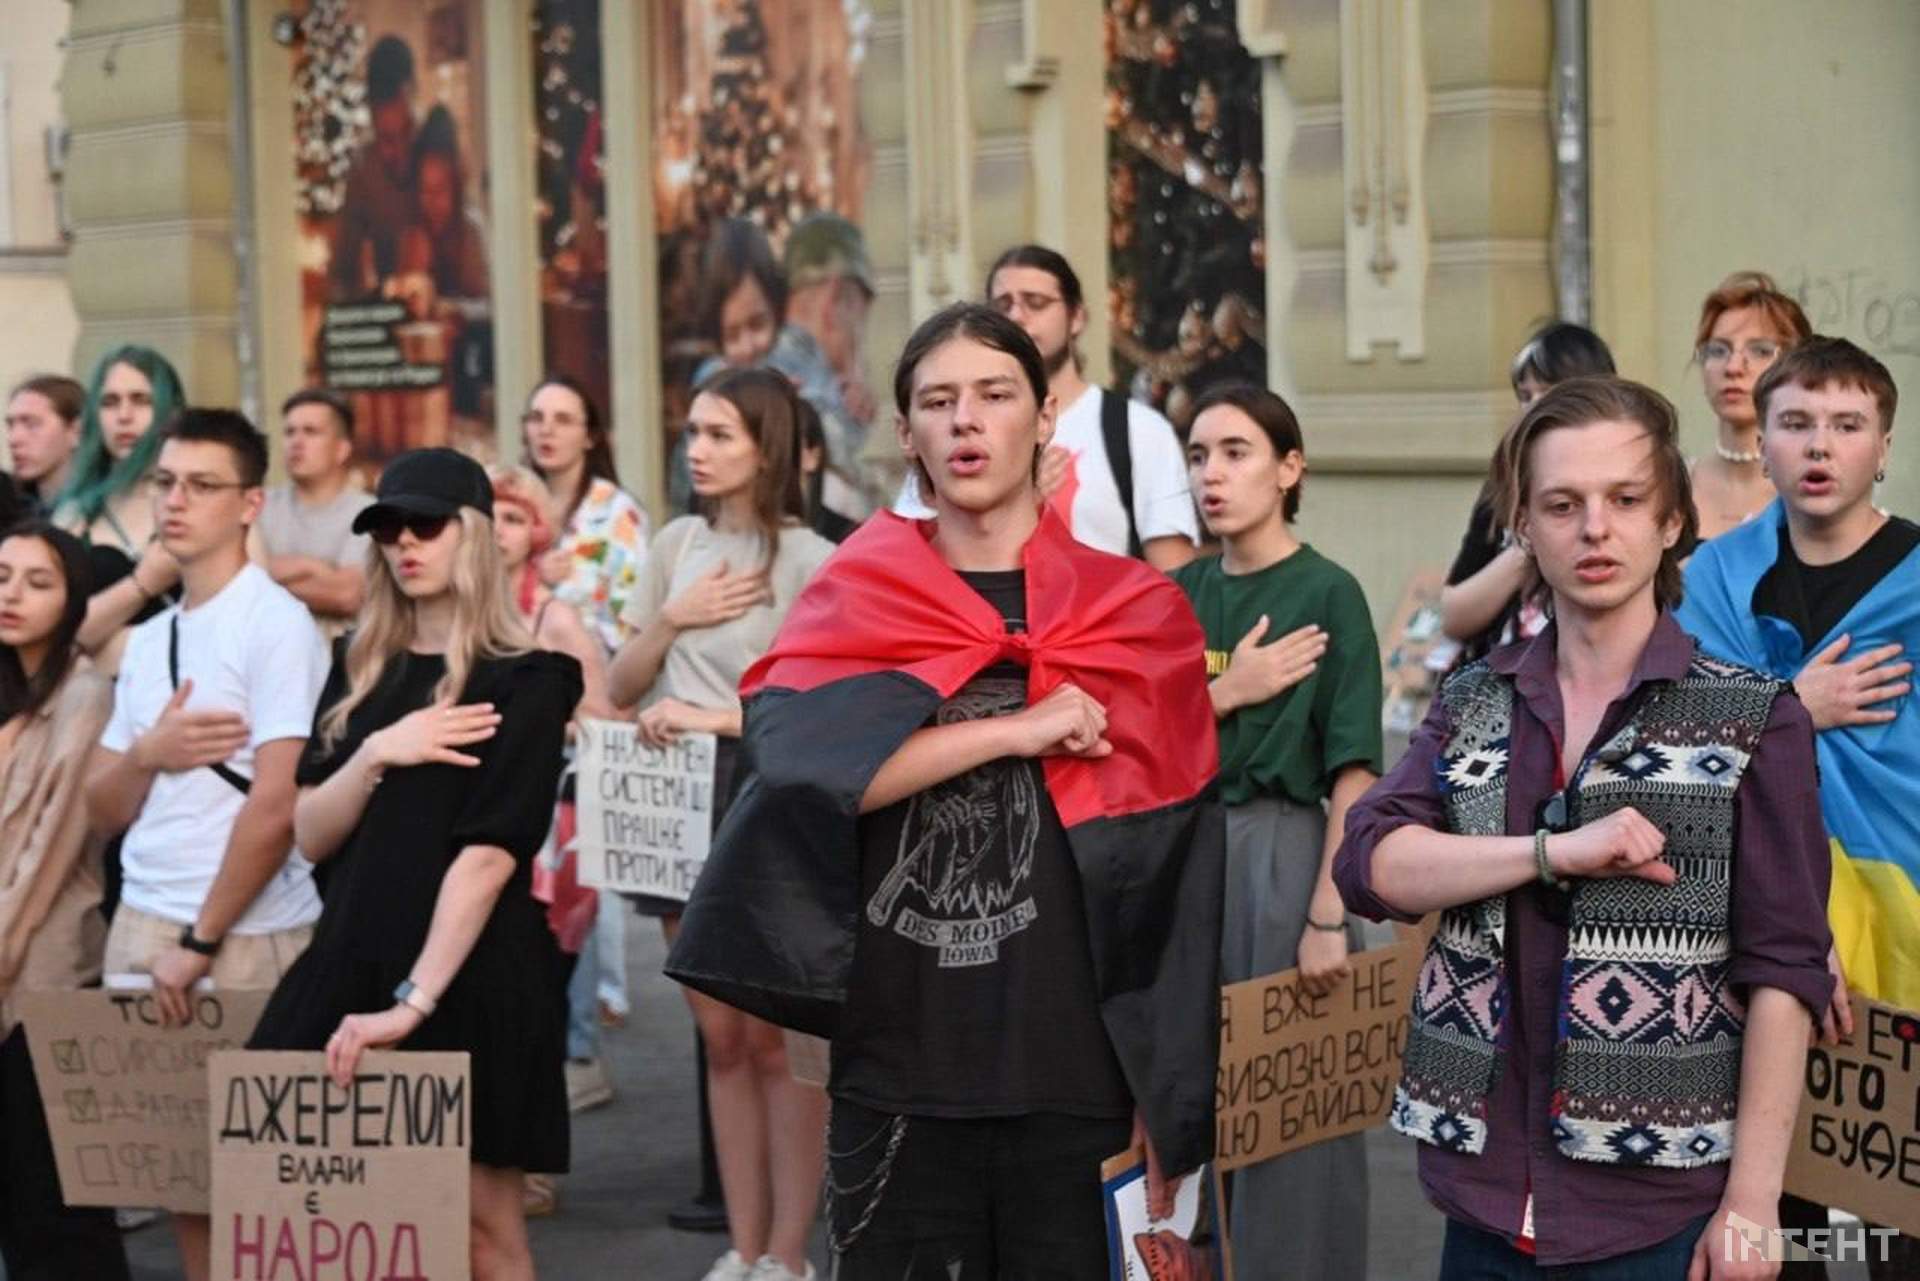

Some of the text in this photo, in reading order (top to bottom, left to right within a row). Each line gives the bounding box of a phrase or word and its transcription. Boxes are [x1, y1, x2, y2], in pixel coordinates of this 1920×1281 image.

[600, 769, 687, 807] СИСТЕМА
[605, 849, 668, 886] ПРОТИ
[903, 914, 937, 942] DES
[945, 945, 994, 961] IOWA
[1353, 958, 1397, 1011] НЕ
[1345, 1013, 1409, 1075] ВСЮ
[220, 1073, 465, 1147] ДЖЕРЕЛОМ
[1281, 1074, 1389, 1141] БАЙДУ
[304, 1191, 320, 1215] Є
[233, 1213, 428, 1281] НАРОД
